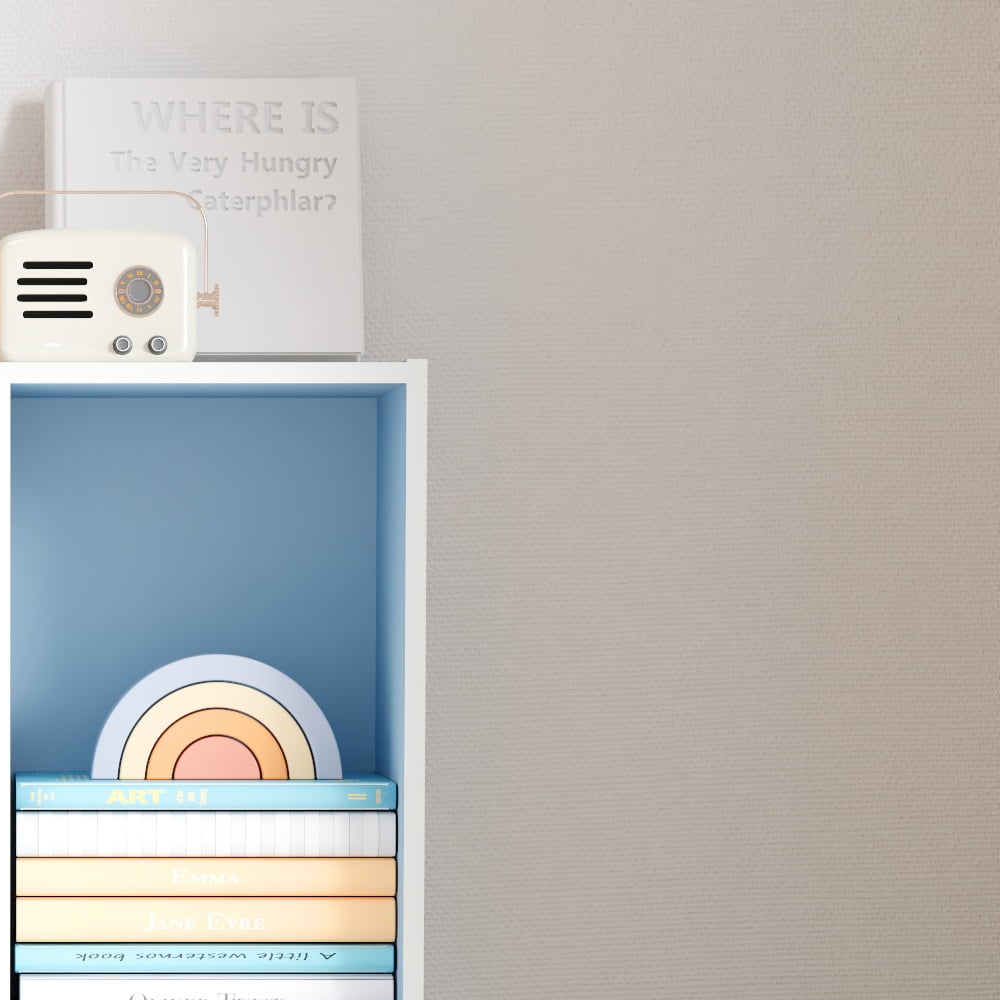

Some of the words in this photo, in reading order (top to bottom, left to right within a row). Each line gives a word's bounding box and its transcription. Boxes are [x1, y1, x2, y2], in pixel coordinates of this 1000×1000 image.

[132, 101, 284, 134] WHERE
[302, 101, 340, 134] IS
[109, 150, 157, 173] The
[169, 151, 229, 179] Very
[241, 151, 338, 179] Hungry
[106, 788, 166, 805] ART
[171, 868, 240, 884] EMMA
[145, 912, 198, 931] JANE
[206, 912, 265, 930] EYRE
[75, 952, 126, 962] book
[136, 952, 247, 961] westernos
[257, 951, 309, 961] little
[319, 952, 337, 960] A
